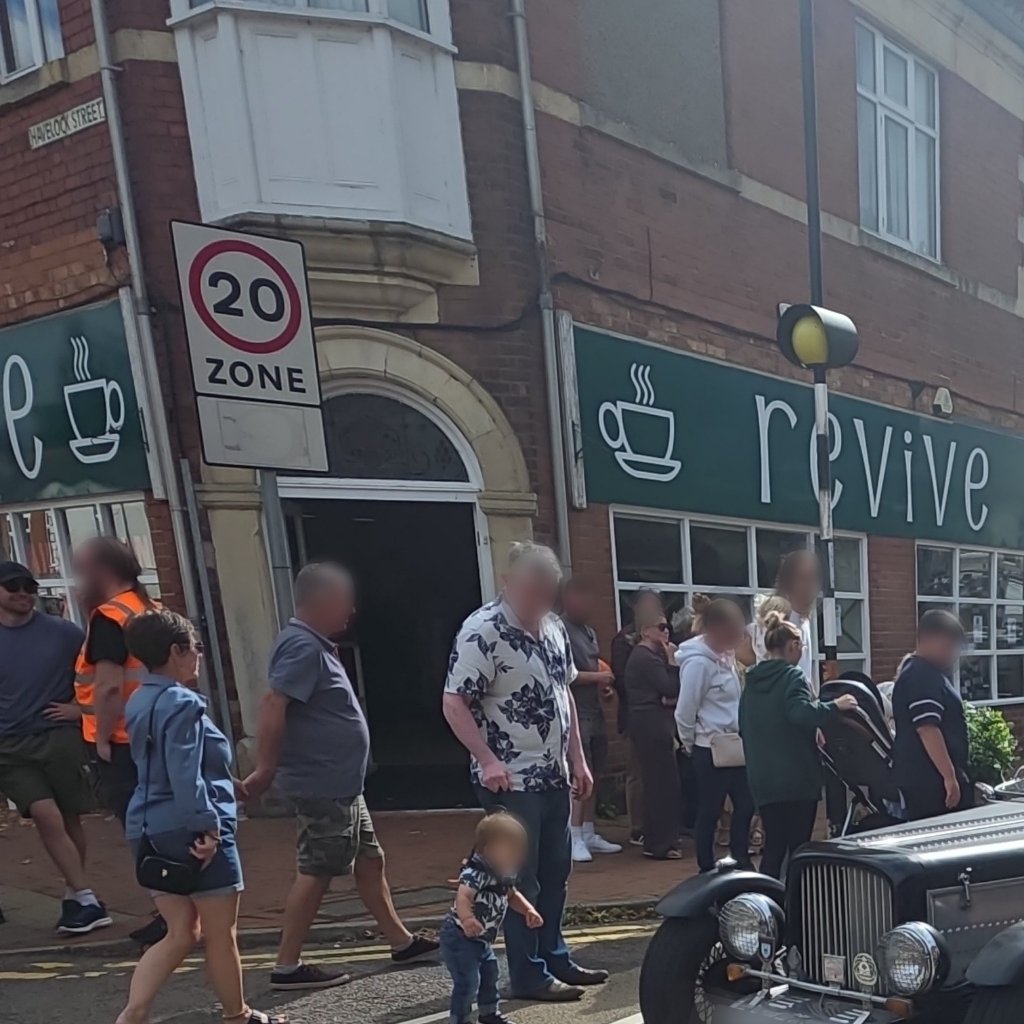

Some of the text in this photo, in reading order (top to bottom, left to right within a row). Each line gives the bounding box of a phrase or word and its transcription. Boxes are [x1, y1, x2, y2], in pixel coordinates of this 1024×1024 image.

[30, 100, 103, 146] HAVELOCK STREET
[208, 271, 285, 322] 20
[205, 357, 306, 394] ZONE
[755, 394, 989, 532] revive
